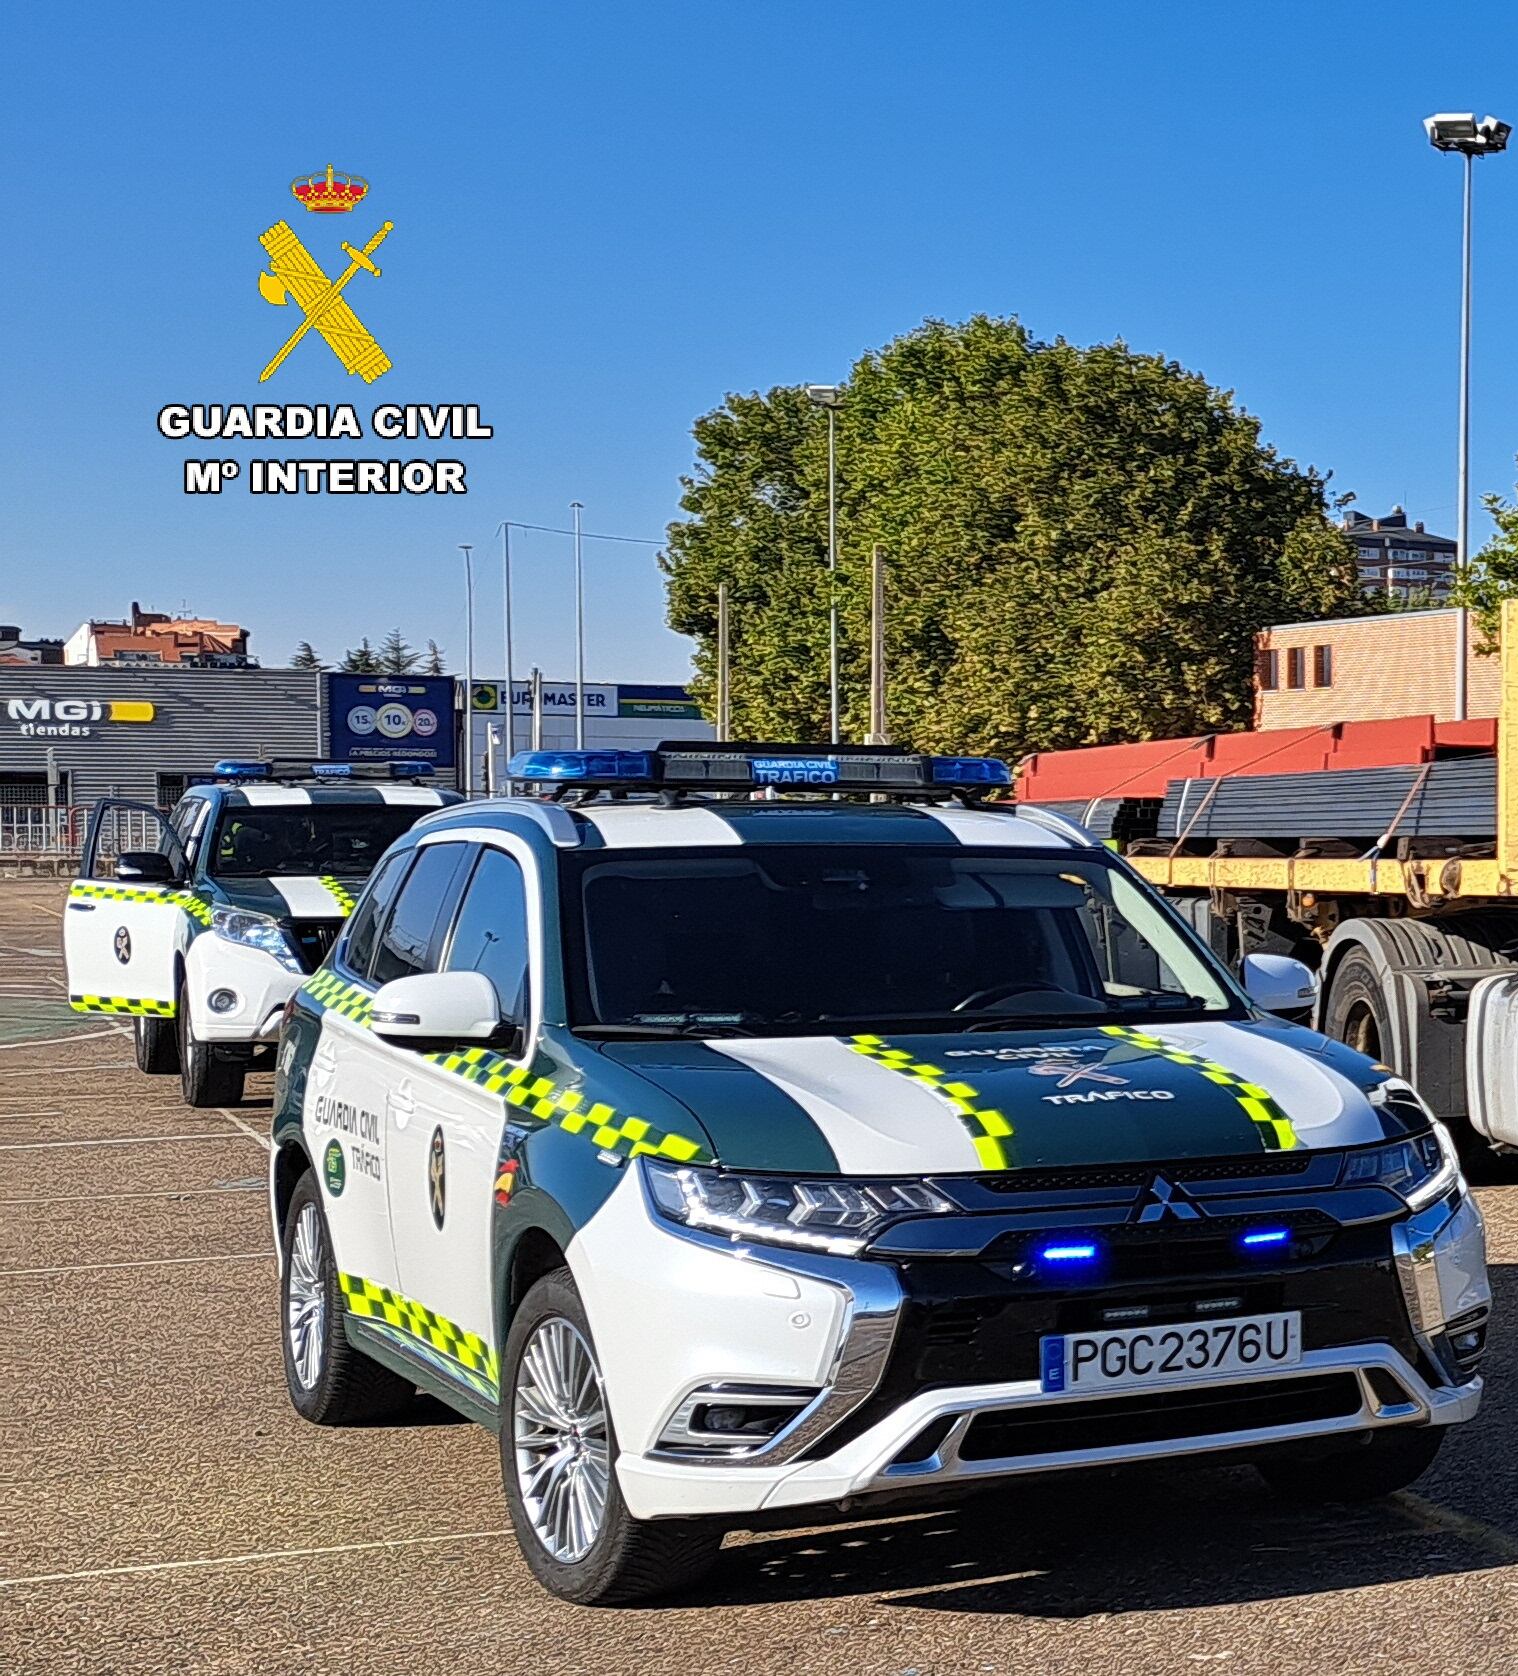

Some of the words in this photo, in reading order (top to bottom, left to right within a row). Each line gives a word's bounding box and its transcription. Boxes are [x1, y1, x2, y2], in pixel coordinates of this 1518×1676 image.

[500, 691, 607, 707] EURMASER
[20, 723, 90, 736] tiendas
[753, 760, 806, 769] GUARDIA
[806, 760, 837, 770] CIVIL
[756, 770, 836, 784] TRAFICO
[944, 1045, 1108, 1057] GUARDIA
[994, 1052, 1085, 1061] CIVIL
[315, 1096, 358, 1136] GUARDIA
[360, 1110, 380, 1145] CIVIL
[1071, 1319, 1290, 1383] PGC2376U
